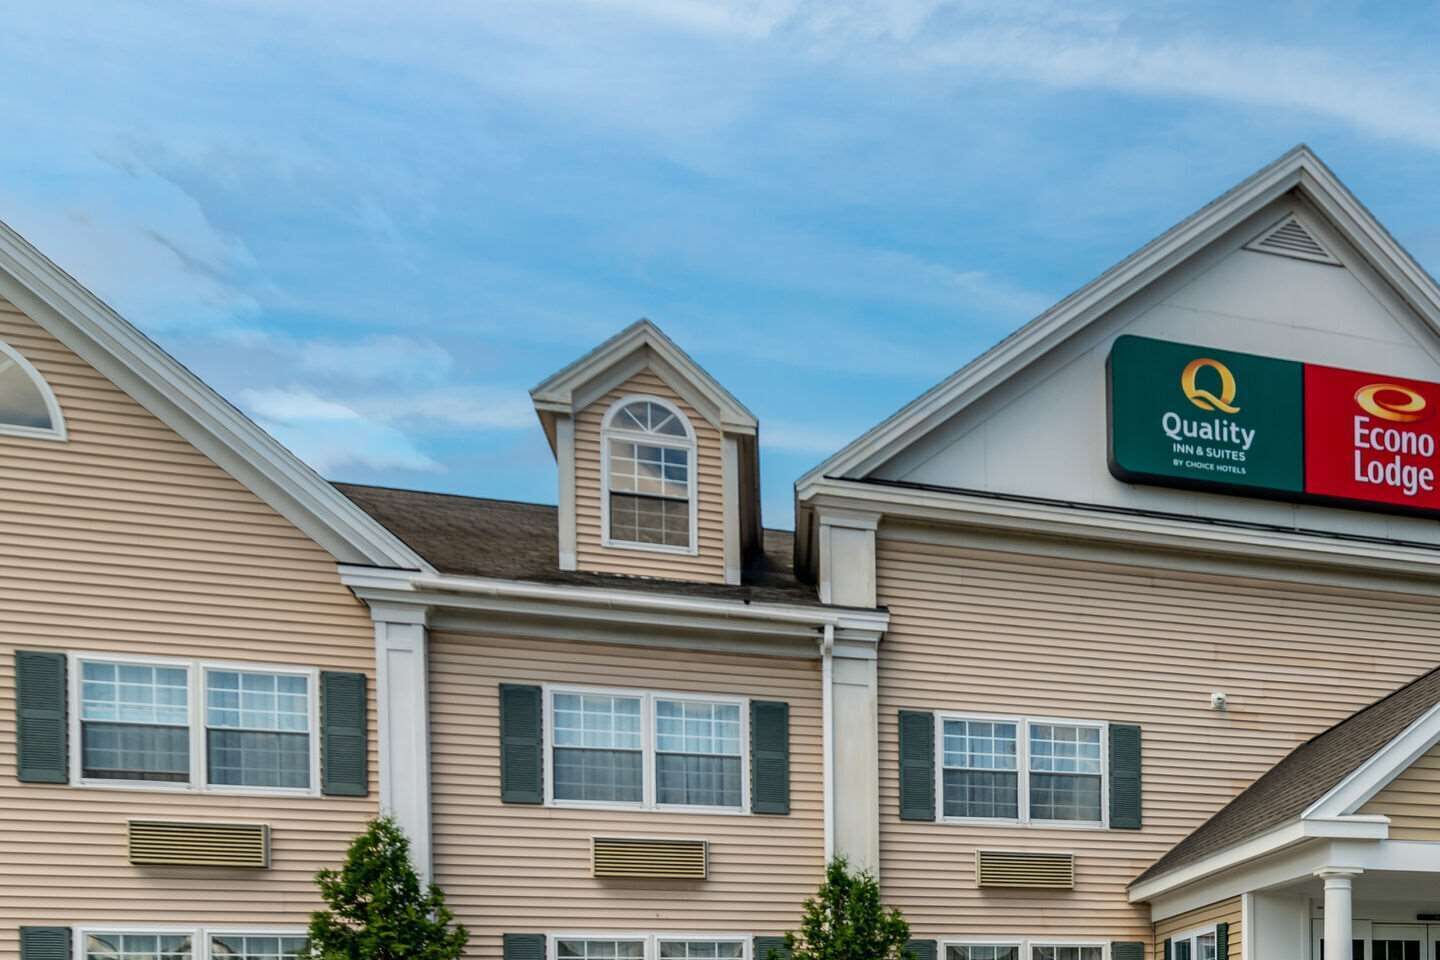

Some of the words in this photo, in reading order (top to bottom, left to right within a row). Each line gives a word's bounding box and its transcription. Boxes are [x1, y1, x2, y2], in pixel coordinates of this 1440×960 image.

[1162, 412, 1255, 450] Quality
[1354, 415, 1434, 457] Econo
[1173, 443, 1194, 455] INN
[1196, 446, 1204, 456] &
[1206, 448, 1246, 461] SUITES
[1173, 459, 1183, 467] BY
[1185, 460, 1215, 471] CHOICE
[1216, 465, 1247, 475] HOTELS
[1354, 449, 1434, 496] Lodge
